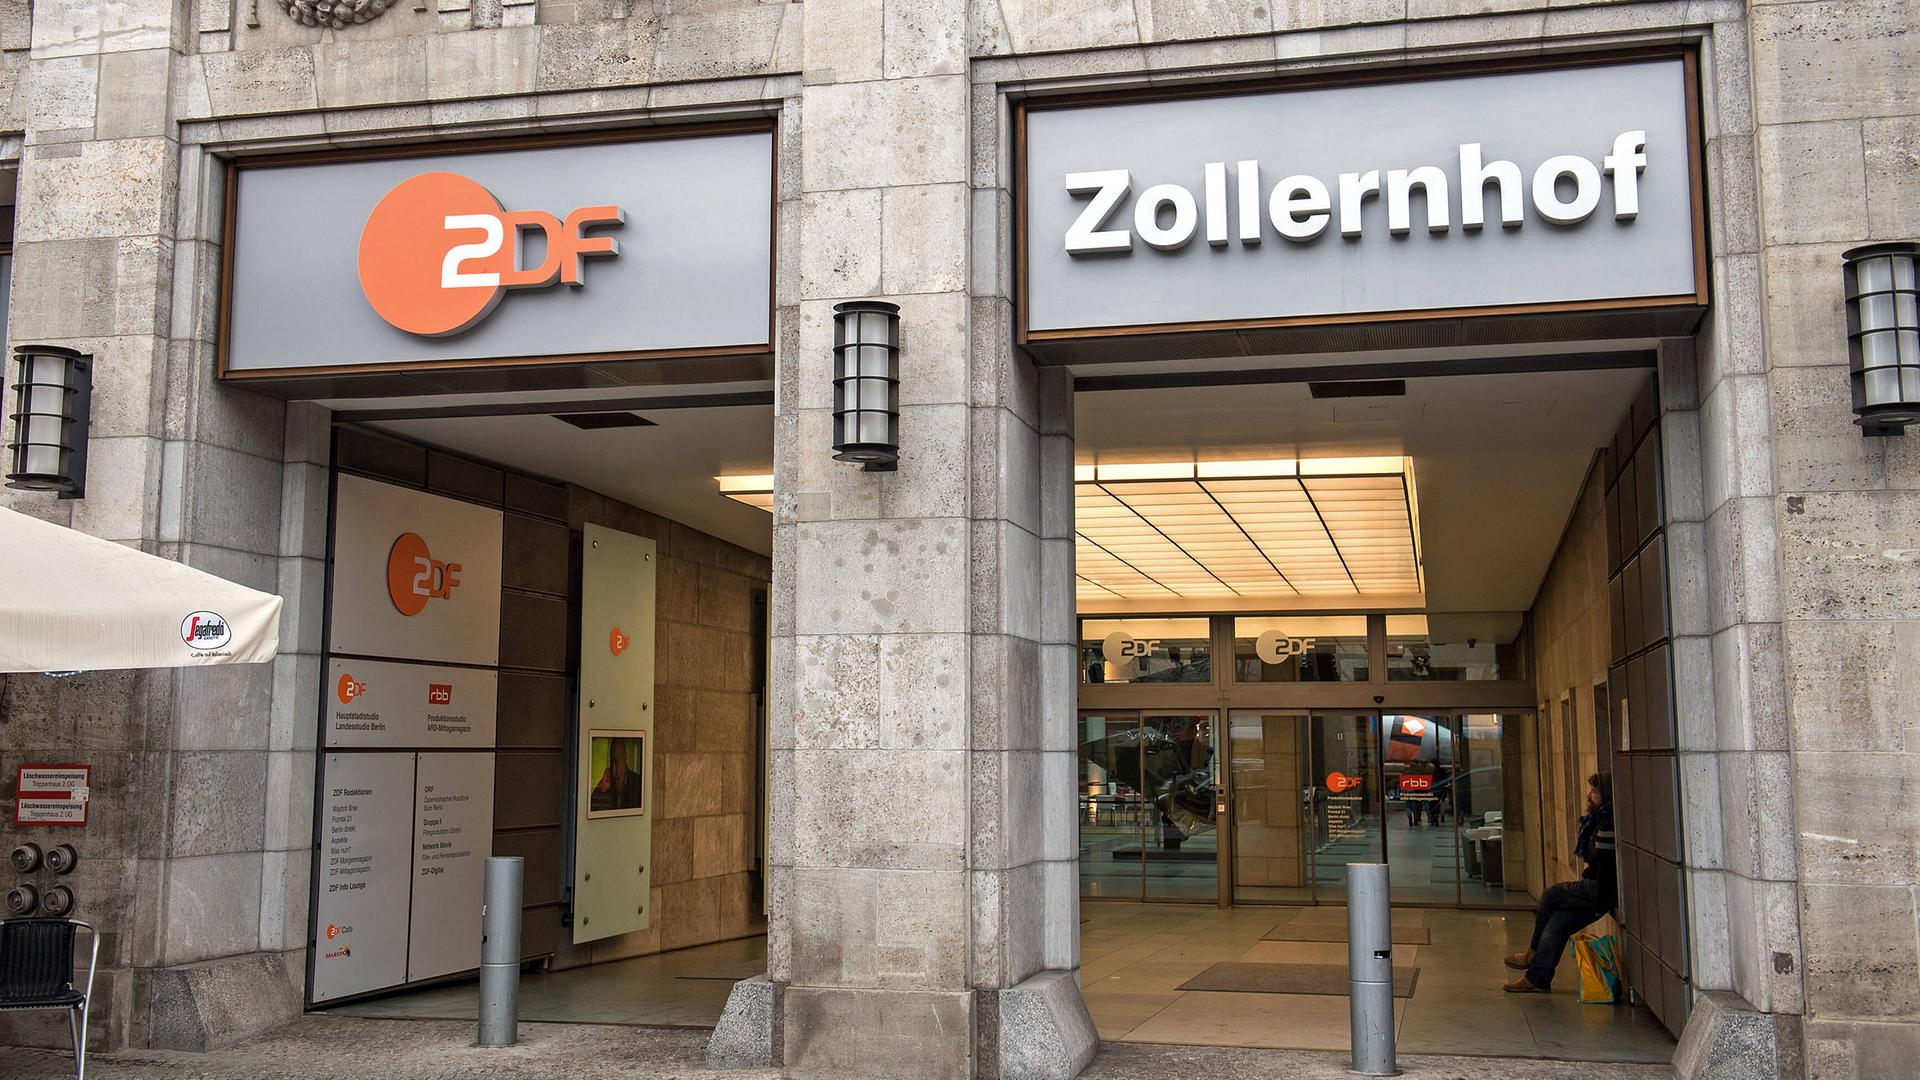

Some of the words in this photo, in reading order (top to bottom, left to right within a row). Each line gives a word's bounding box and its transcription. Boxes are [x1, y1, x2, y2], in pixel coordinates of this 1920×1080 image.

[1065, 130, 1647, 256] Zollernhof
[441, 205, 623, 288] ZDF
[413, 556, 462, 600] ZDF
[186, 616, 224, 641] Segafredo
[1121, 640, 1160, 657] ZDF
[1275, 638, 1316, 655] ZDF
[346, 682, 366, 697] ZDF
[430, 688, 449, 701] rbb
[336, 711, 379, 721] Hauptstadtstudio
[427, 714, 466, 723] Produktionsstudio
[335, 722, 370, 731] Landesstudio
[371, 722, 385, 731] Berlin
[1337, 777, 1361, 788] ZDF
[1402, 778, 1429, 788] rbb
[333, 788, 343, 797] ZDF
[329, 884, 339, 893] ZDF
[339, 882, 348, 891] Info
[349, 882, 366, 891] Lounge
